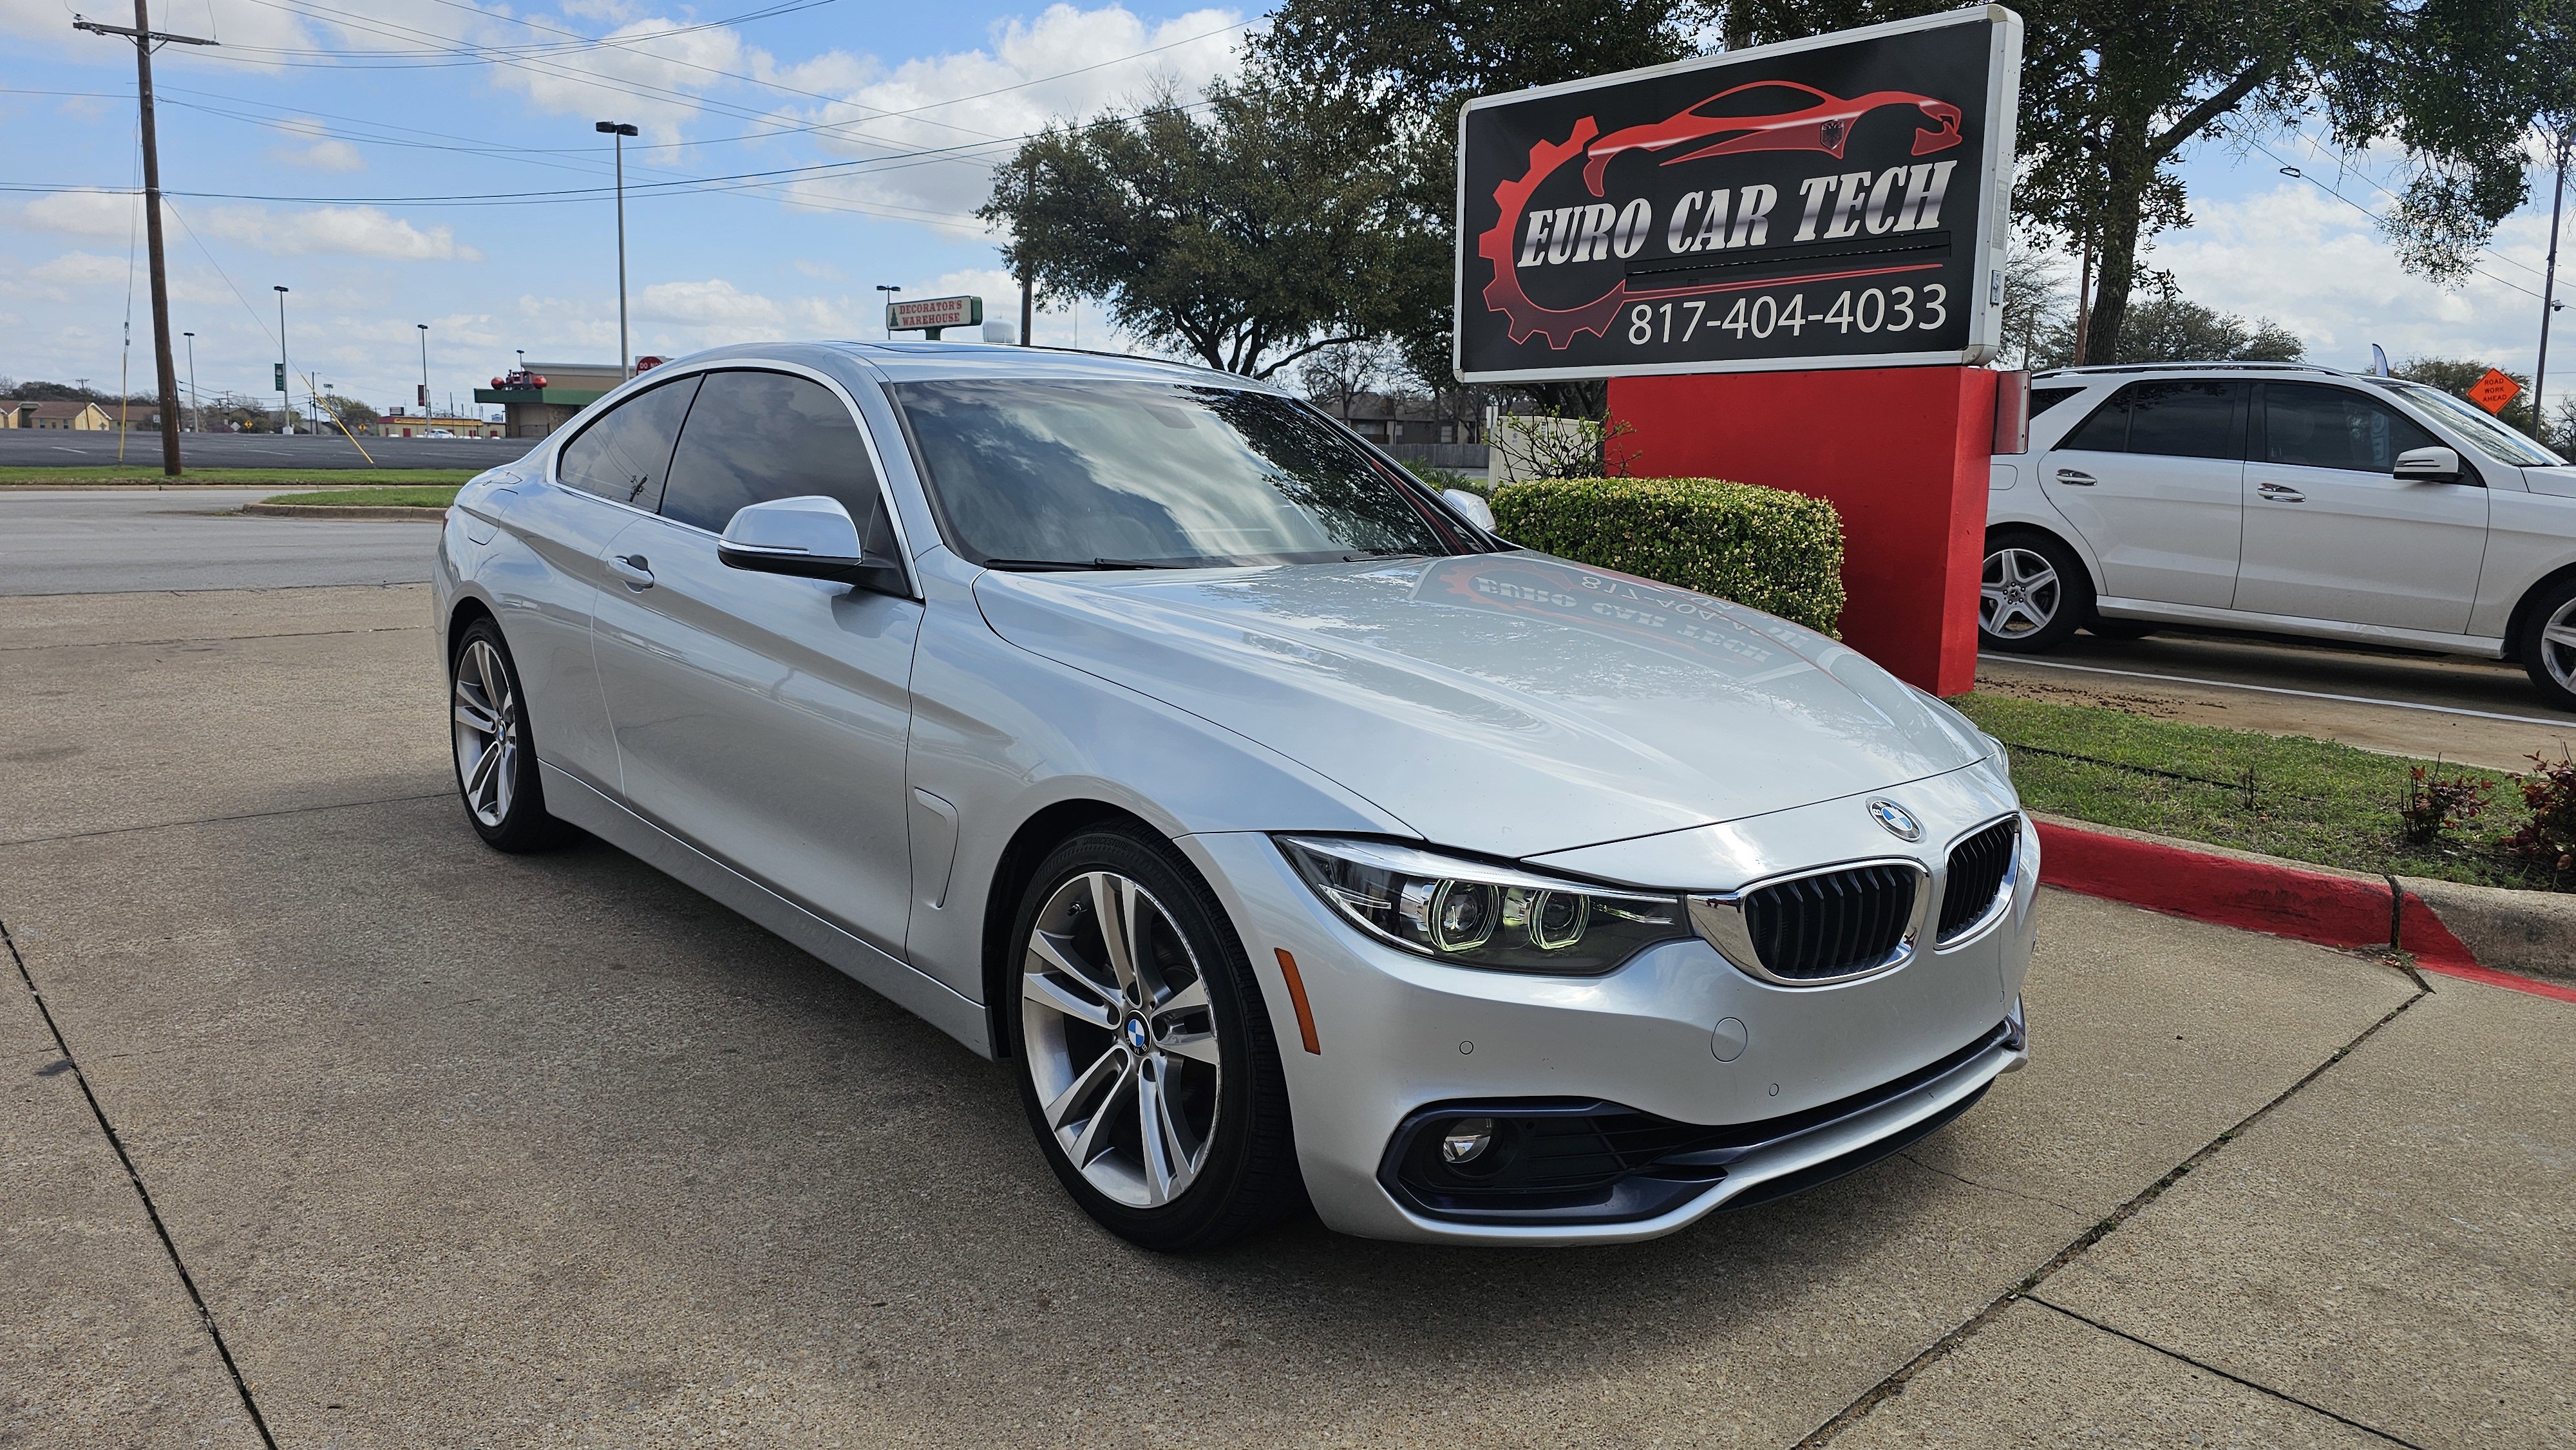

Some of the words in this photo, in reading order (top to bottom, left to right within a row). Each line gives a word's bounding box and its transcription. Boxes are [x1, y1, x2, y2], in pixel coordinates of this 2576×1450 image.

[1517, 198, 1653, 268] EURO
[1667, 184, 1777, 254] CAR
[1793, 160, 1958, 242] TECH
[899, 299, 962, 315] DECORATOR'S
[1627, 283, 1947, 345] 817-404-4033
[902, 312, 960, 326] WAREHOUSE
[1083, 836, 1128, 850] BRIDGESTONE
